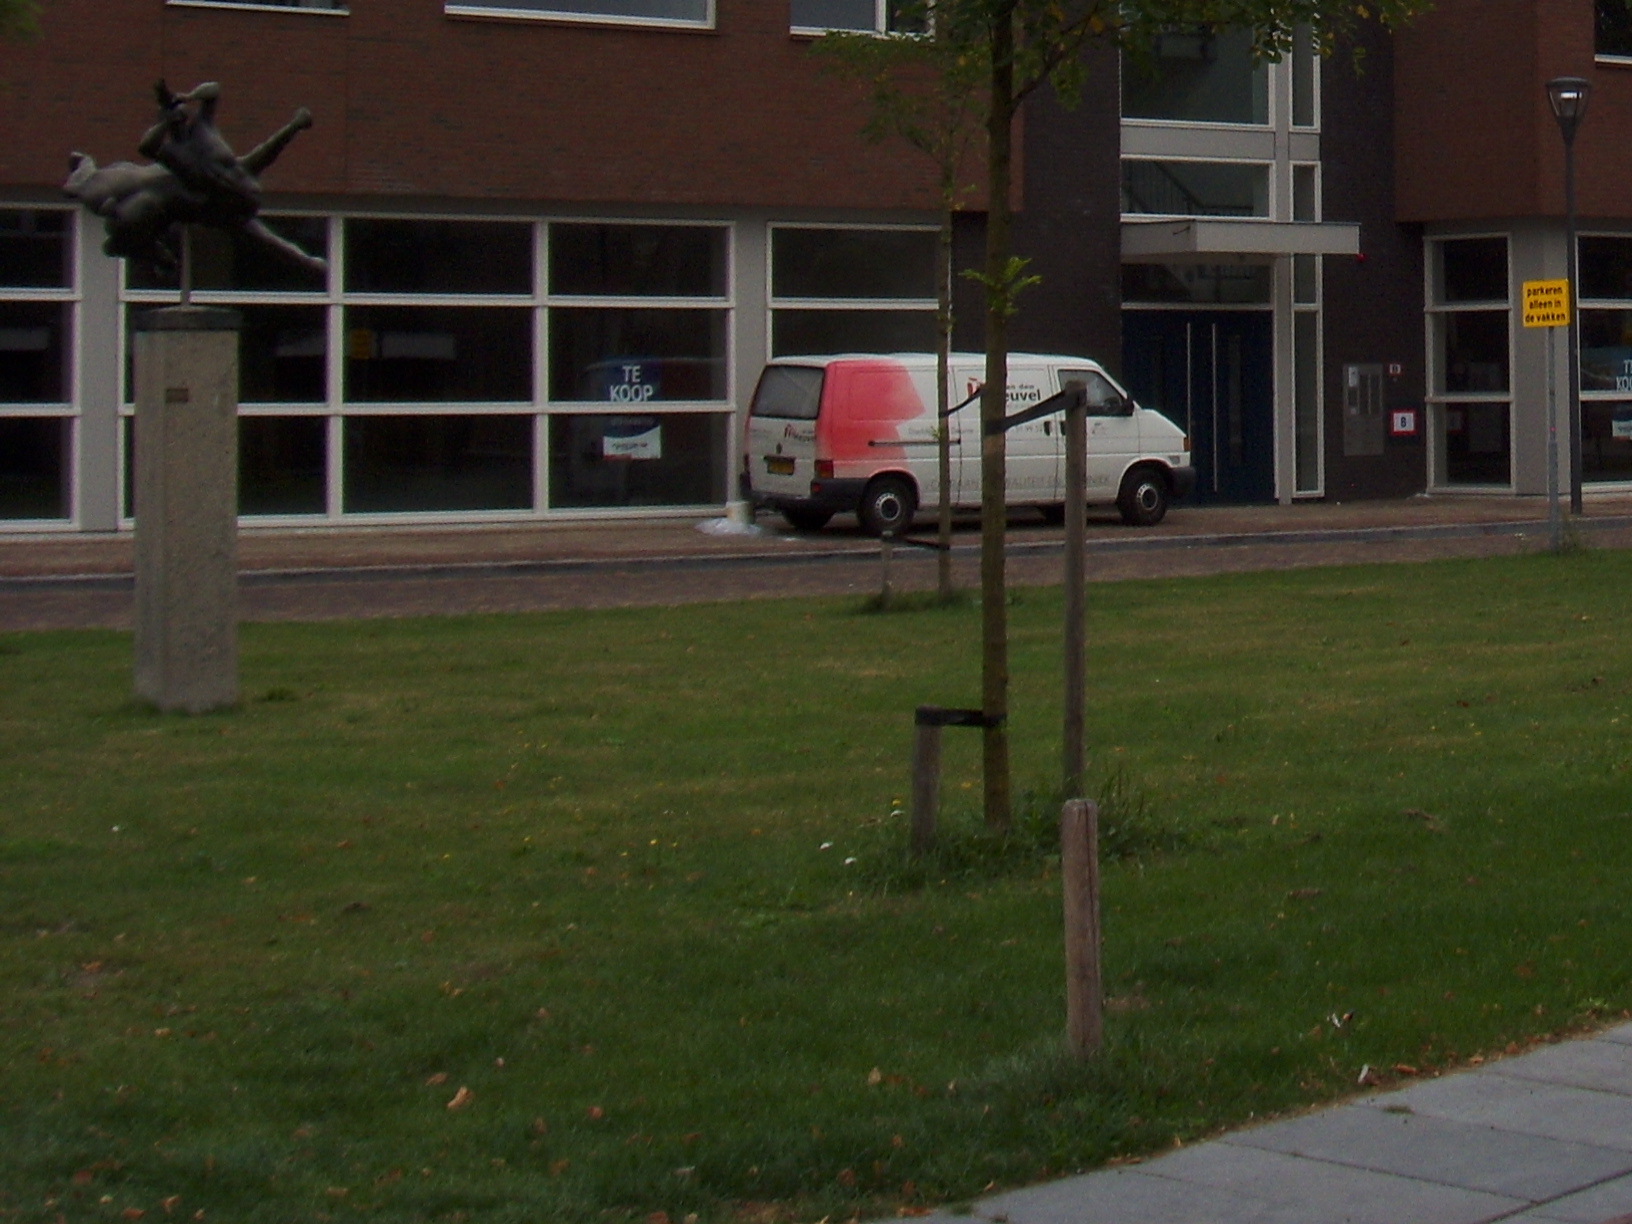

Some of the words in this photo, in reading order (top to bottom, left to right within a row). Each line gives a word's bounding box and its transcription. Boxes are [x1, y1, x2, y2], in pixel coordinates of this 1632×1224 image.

[1527, 286, 1563, 297] parkeren
[1529, 299, 1552, 309] alleen
[1554, 299, 1562, 308] in
[1525, 314, 1534, 323] de
[1536, 312, 1566, 322] vakken
[622, 365, 641, 383] TE
[610, 384, 654, 402] KOOP
